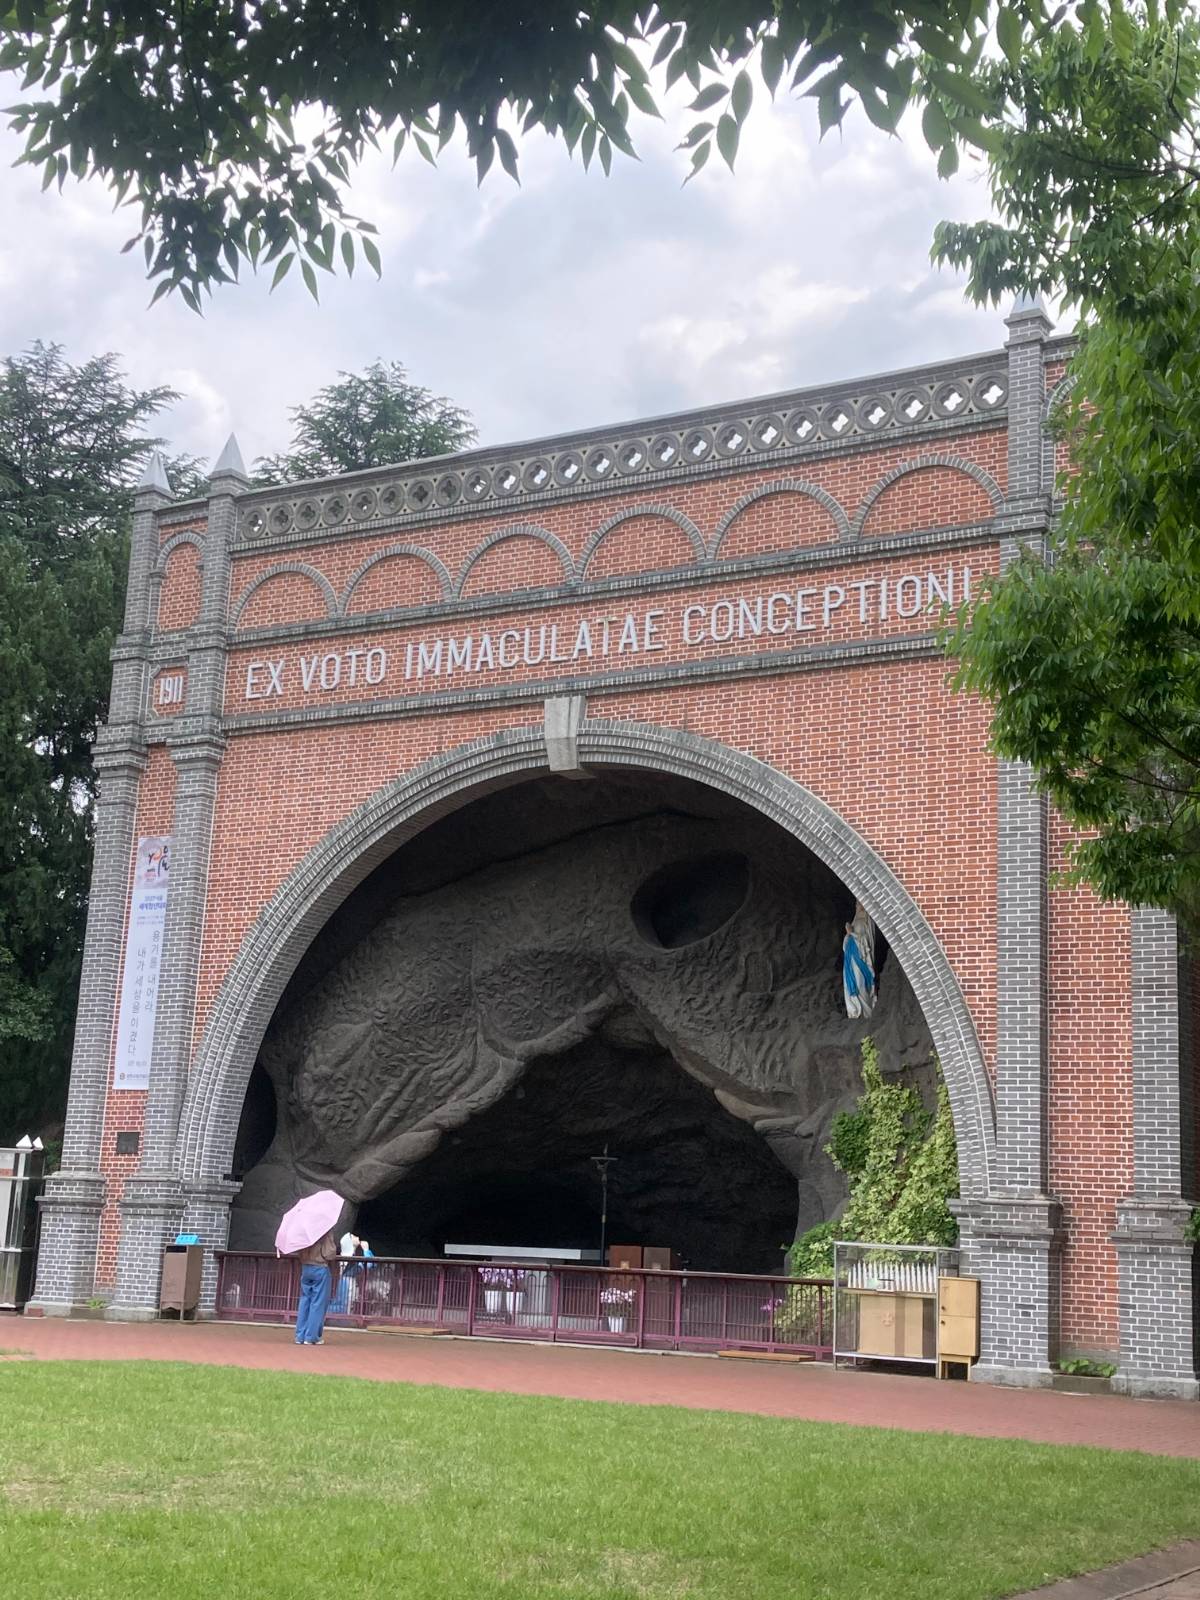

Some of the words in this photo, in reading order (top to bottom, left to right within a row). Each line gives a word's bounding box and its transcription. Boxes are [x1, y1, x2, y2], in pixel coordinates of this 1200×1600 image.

[245, 660, 285, 699] EX
[300, 648, 387, 693] VOTO
[405, 609, 665, 680] IMMACULATAE
[683, 566, 972, 646] CONCEPTIONI
[160, 676, 183, 704] 1911
